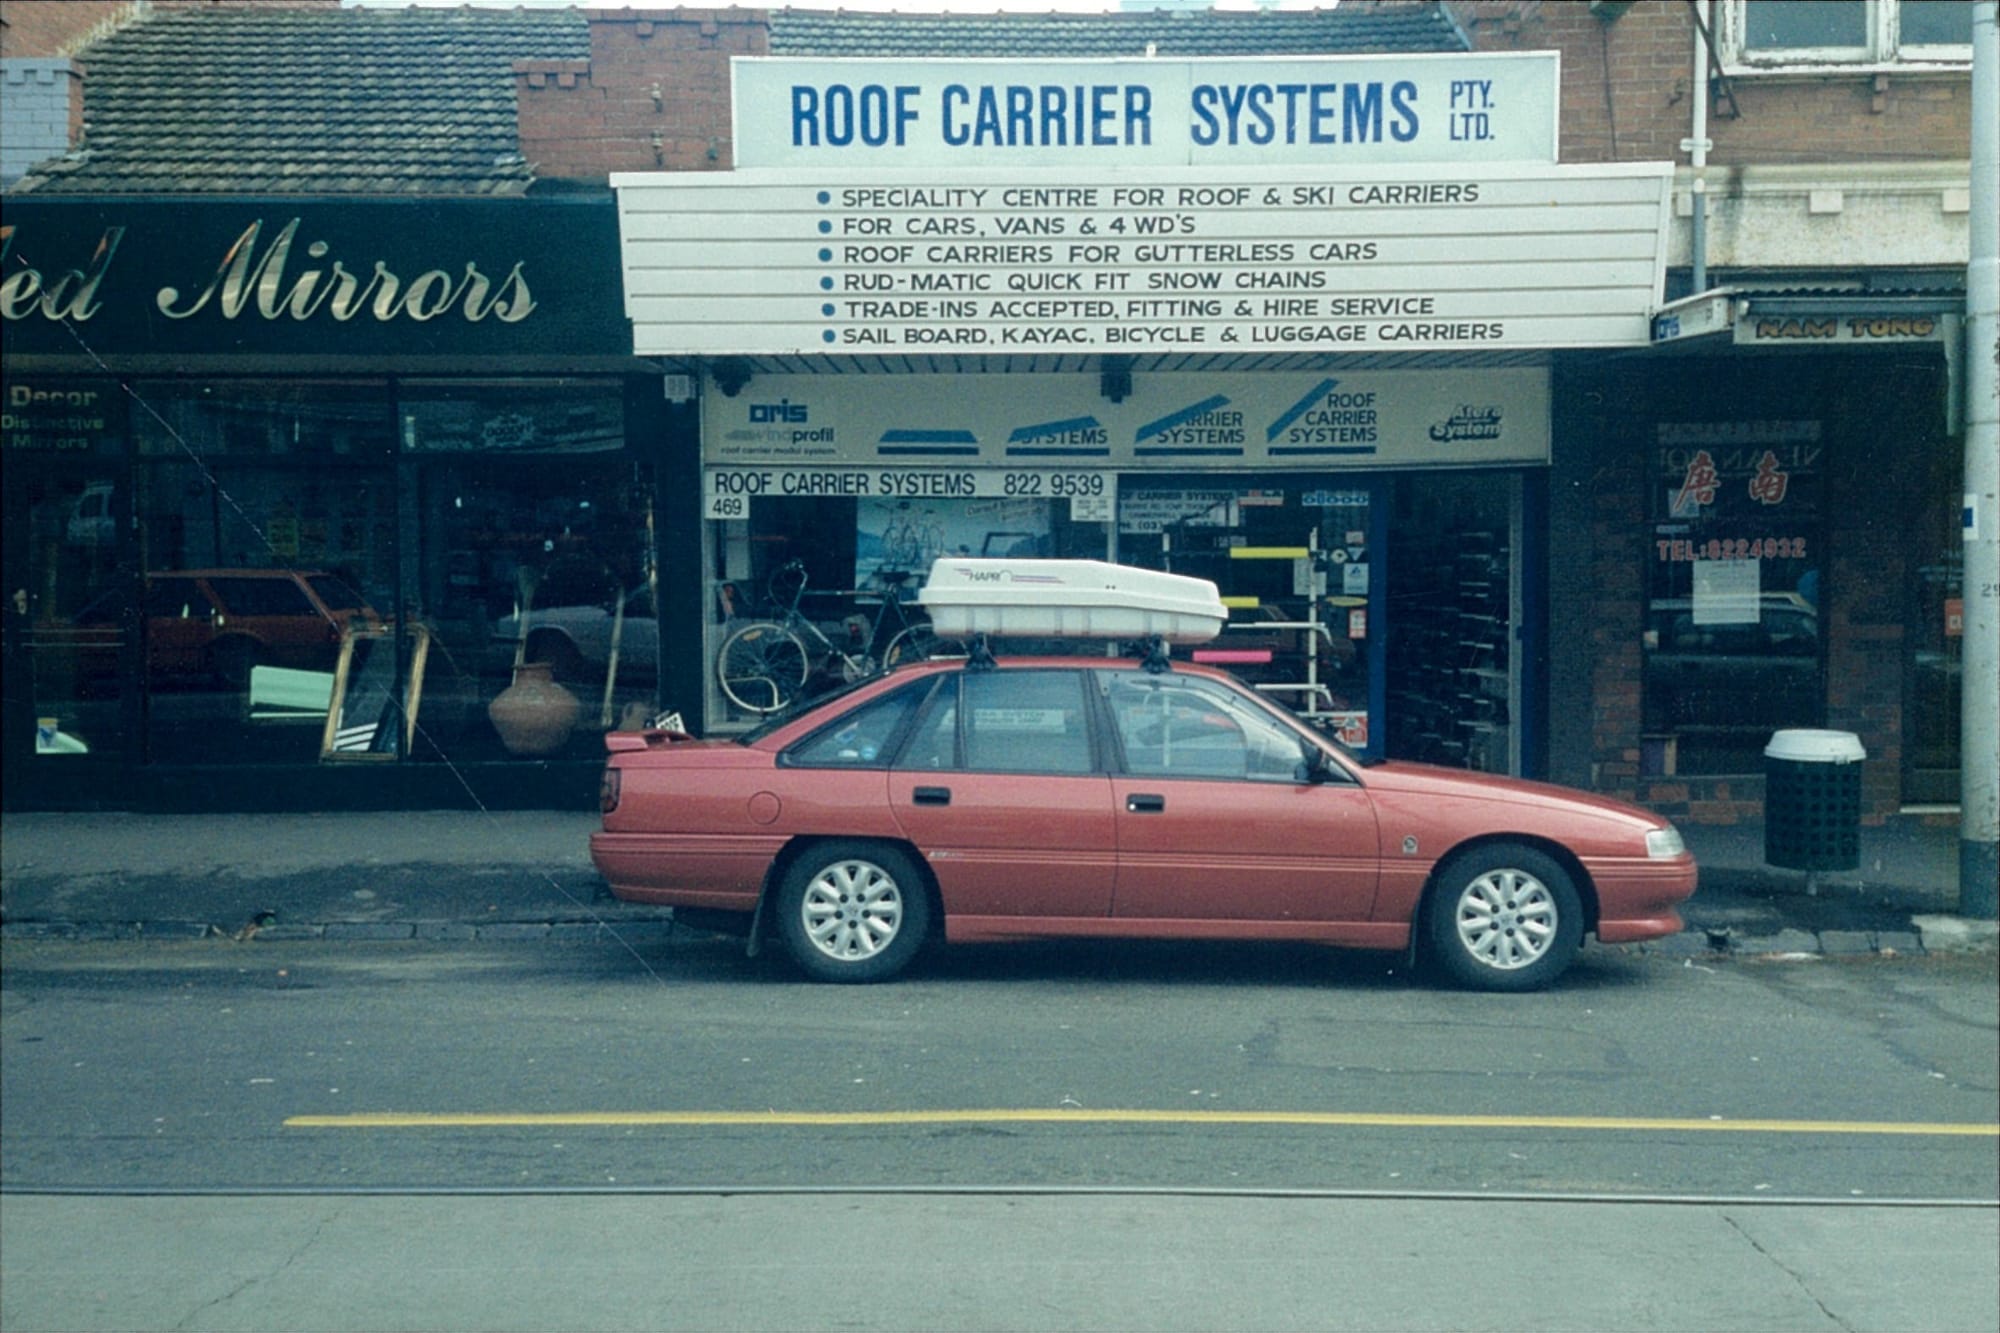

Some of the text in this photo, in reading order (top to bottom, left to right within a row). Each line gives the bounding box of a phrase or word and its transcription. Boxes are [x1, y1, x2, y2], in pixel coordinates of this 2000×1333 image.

[1450, 80, 1495, 108] PTY.
[791, 81, 1419, 147] ROOF CARRIER SYSTEMS
[1450, 113, 1495, 140] LTD.
[842, 183, 1479, 208] SPECIALITY CENTRE FOR ROOF & SKI CARRIERS
[843, 217, 892, 235] FOR
[994, 217, 1065, 235] VANS
[1079, 217, 1097, 235] &
[1109, 217, 1126, 234] 4
[1134, 213, 1195, 234] WD'S
[844, 242, 1378, 264] ROOF CARRIERS FOR GUTTERLESS CARS
[0, 217, 537, 323] ed Mirrors
[1007, 273, 1082, 292] QUICK
[1095, 272, 1131, 290] FIT
[1148, 272, 1222, 290] SNOW
[1235, 270, 1326, 289] CHAINS
[844, 301, 978, 318] TRADE-INS
[1127, 299, 1222, 317] FITTING
[1233, 299, 1253, 317] &
[1263, 299, 1319, 317] HIRE
[1330, 297, 1434, 316] SERVICE
[843, 328, 897, 344] SAIL
[1105, 326, 1205, 343] BICYCLE
[1220, 326, 1239, 343] &
[1252, 325, 1367, 343] LUGGAGE
[1378, 323, 1504, 341] CARRIERS
[1756, 316, 1934, 339] NAM TONG
[9, 385, 99, 407] Decor
[1327, 392, 1377, 409] ROOF
[749, 398, 808, 423] oris
[1304, 409, 1378, 426] CARRIER
[12, 433, 89, 450] Mirrors
[1157, 427, 1246, 445] SYSTEMS
[1289, 426, 1378, 444] SYSTEMS
[715, 472, 1104, 496] ROOF CARRIER SYSTEMS 822 9539
[711, 498, 743, 516] 469
